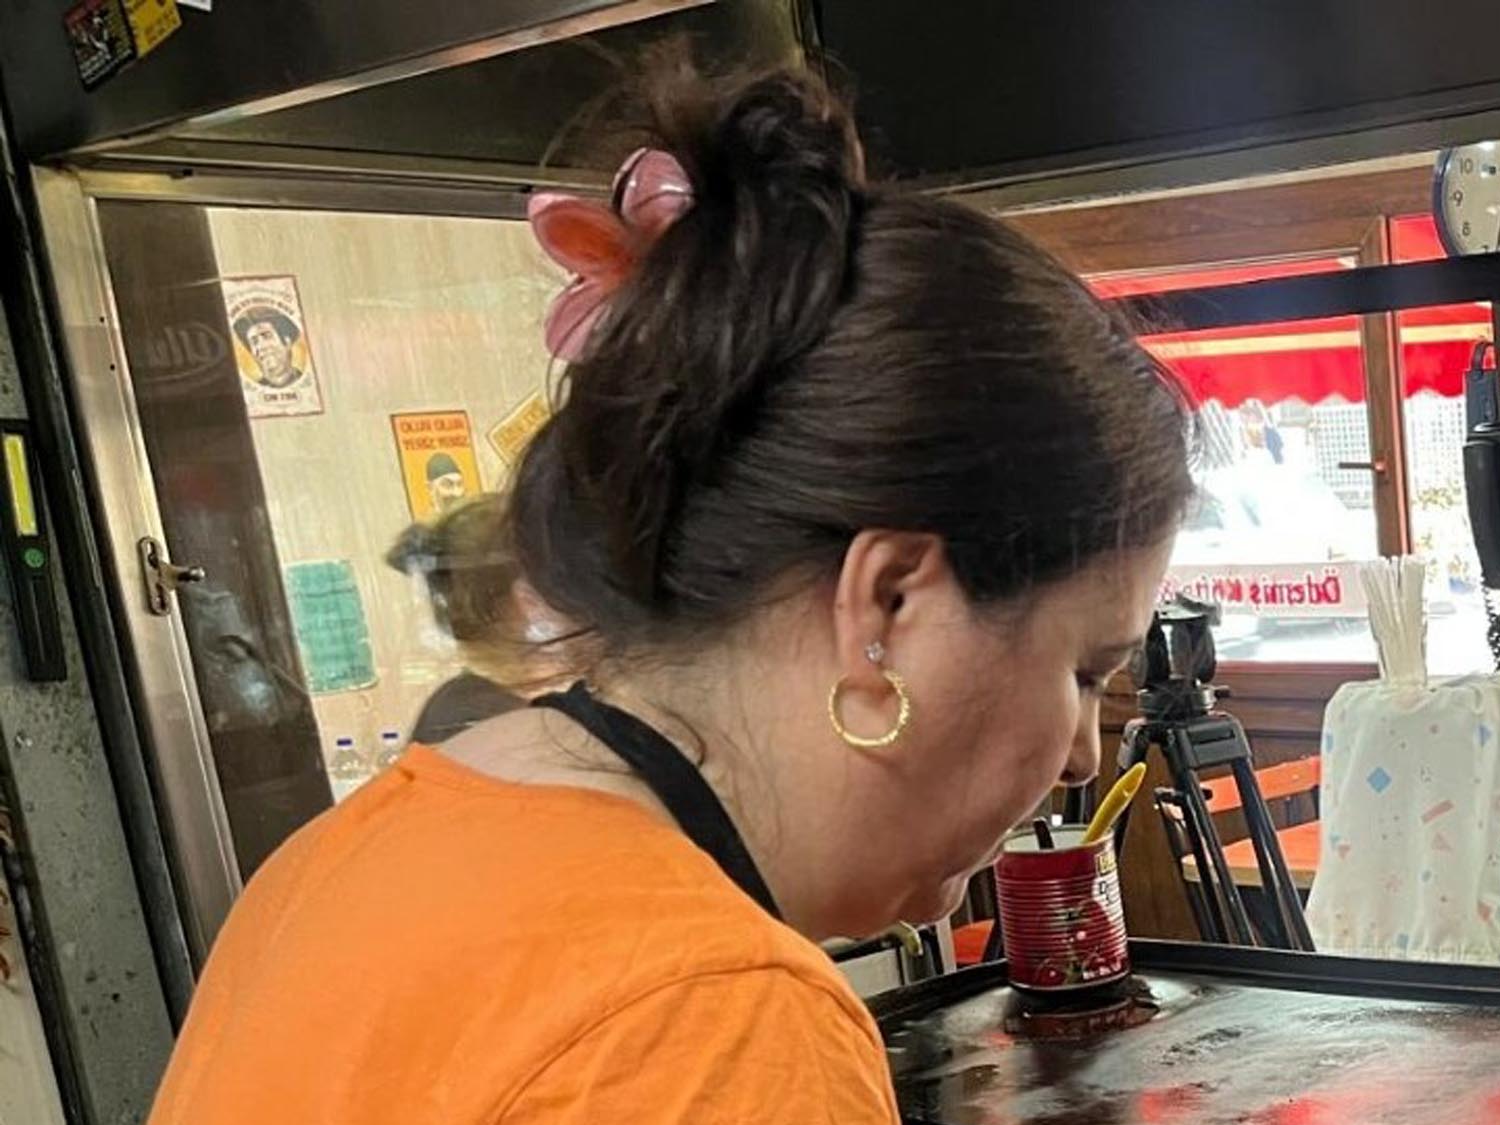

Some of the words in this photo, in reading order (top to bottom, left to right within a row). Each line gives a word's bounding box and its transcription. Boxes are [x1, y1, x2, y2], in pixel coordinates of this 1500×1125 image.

[1458, 157, 1474, 175] 10
[1452, 190, 1463, 207] 9
[1462, 221, 1472, 237] 8
